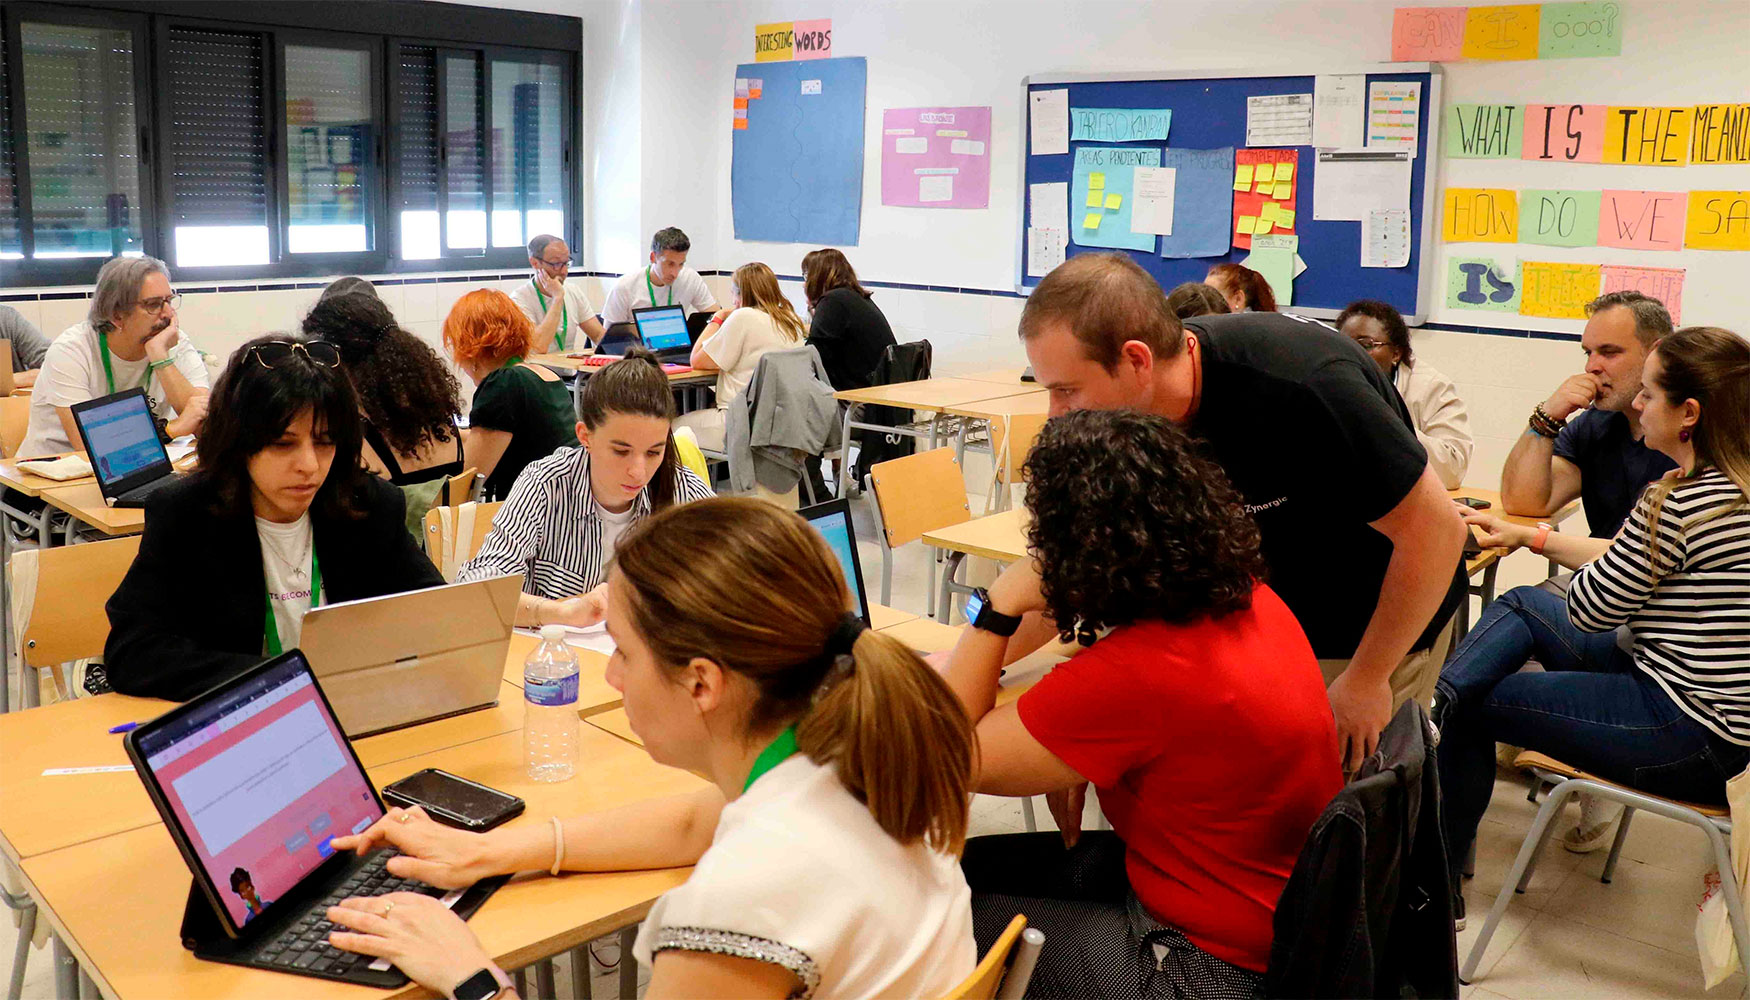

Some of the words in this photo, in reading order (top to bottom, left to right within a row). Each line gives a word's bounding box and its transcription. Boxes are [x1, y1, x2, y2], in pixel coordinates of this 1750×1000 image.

[794, 30, 831, 52] WORDS
[1484, 11, 1519, 49] I
[1456, 105, 1515, 156] WHAT
[1539, 105, 1584, 160] IS
[1618, 109, 1684, 163] THE
[1691, 106, 1750, 163] MEANI
[1454, 194, 1511, 237] HOW
[1538, 196, 1577, 238] DO
[1612, 197, 1674, 243] WE
[1457, 262, 1515, 304] IS
[1528, 267, 1600, 307] THIS
